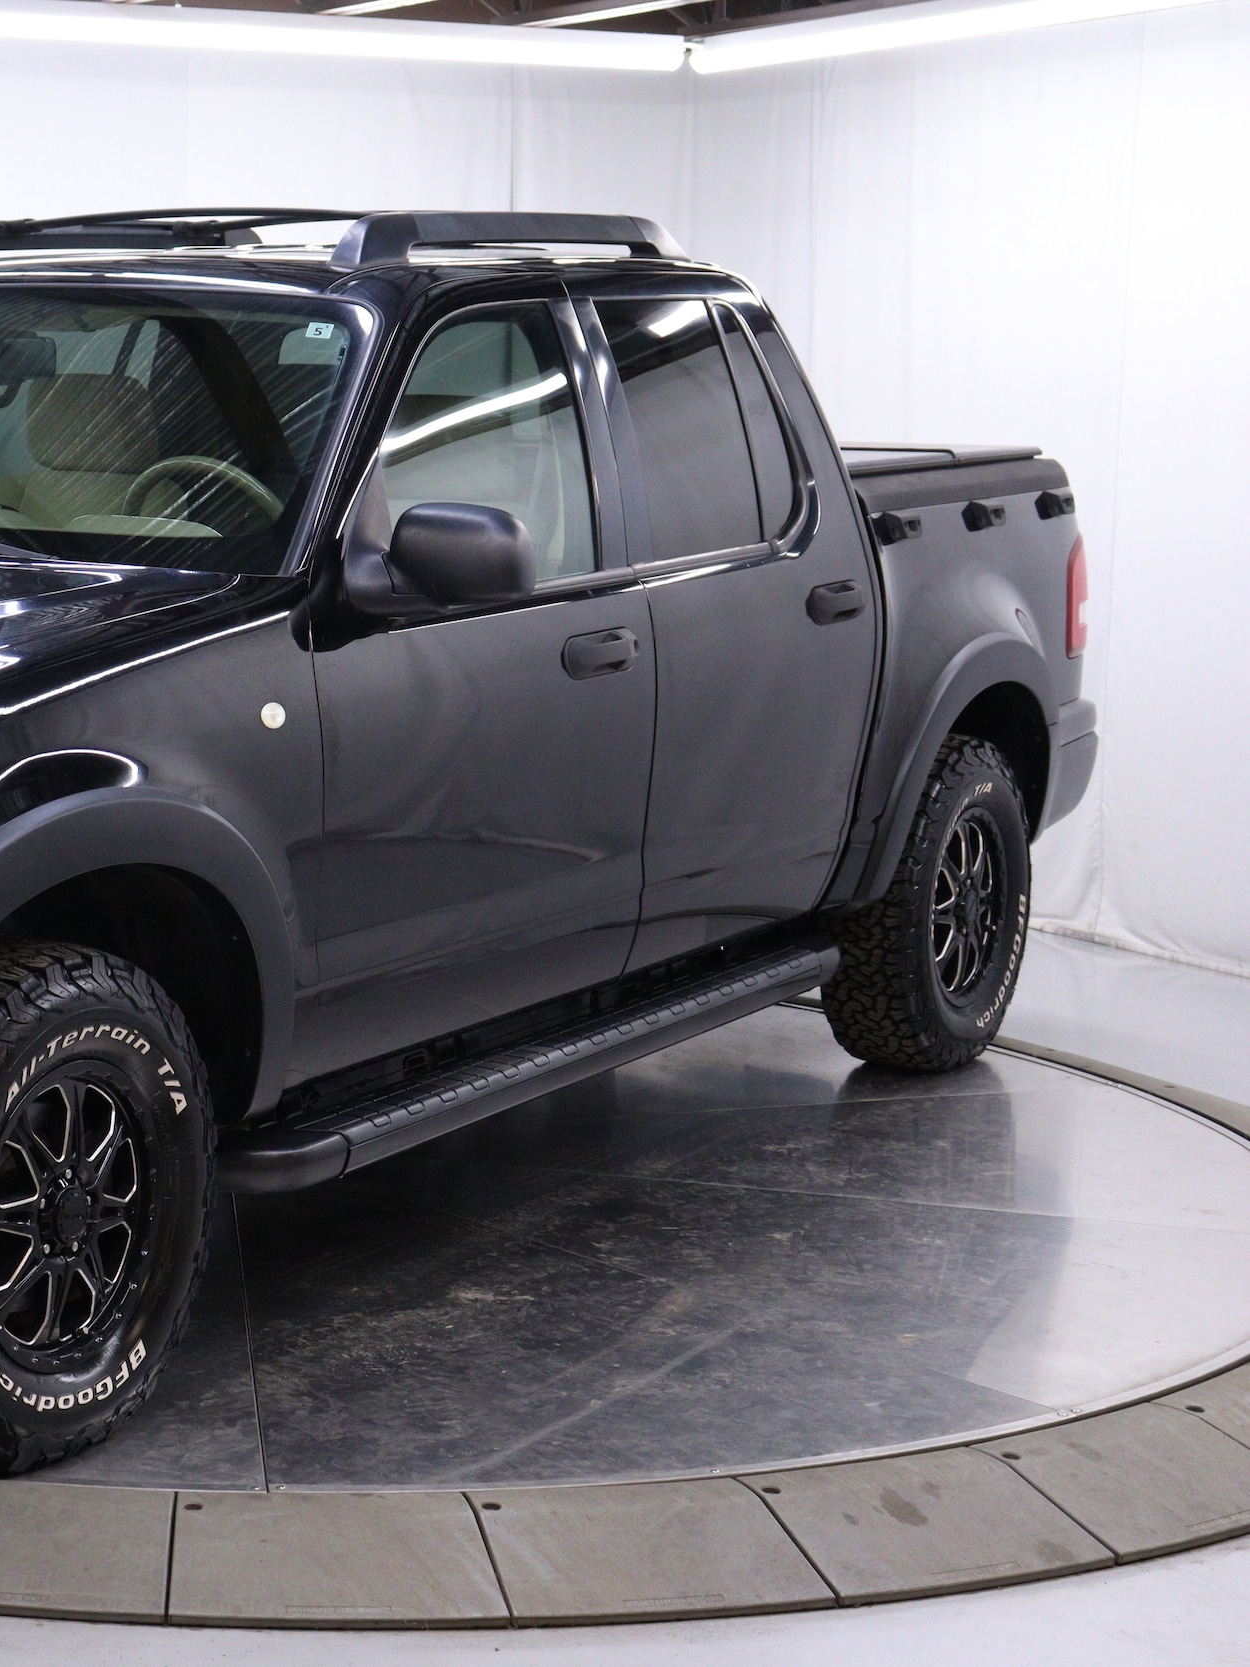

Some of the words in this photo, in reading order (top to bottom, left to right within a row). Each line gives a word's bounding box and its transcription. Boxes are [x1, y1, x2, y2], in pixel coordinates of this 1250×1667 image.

[313, 327, 323, 336] 5
[974, 782, 993, 797] T/A
[976, 893, 1026, 1029] BFGoodrich
[4, 1024, 151, 1113] All-Terrain
[156, 1057, 188, 1115] T/A
